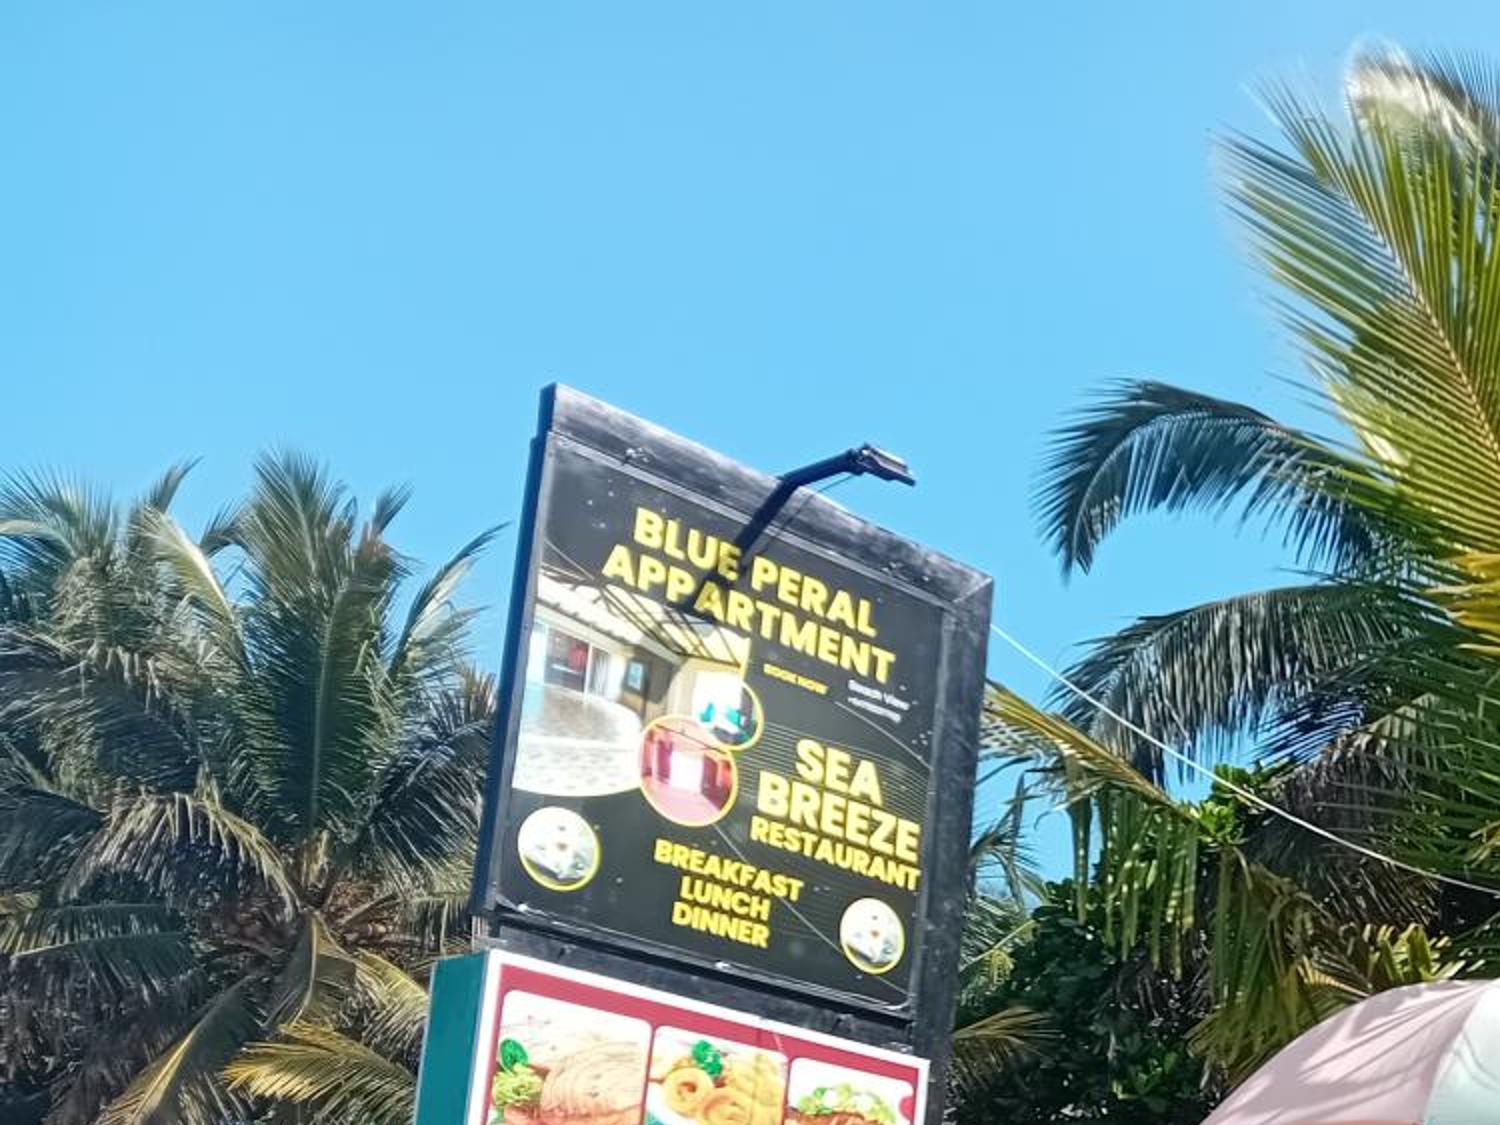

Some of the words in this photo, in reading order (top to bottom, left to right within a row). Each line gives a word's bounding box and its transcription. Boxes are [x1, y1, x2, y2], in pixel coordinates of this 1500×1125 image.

[633, 507, 741, 580] BLUE
[751, 556, 877, 637] PERAL
[602, 544, 896, 685] APPARTMENT
[795, 739, 882, 806] SEA
[757, 770, 921, 862] BREEZE
[654, 839, 804, 901] BREAKFAST
[751, 816, 921, 890] RESTAURANT
[672, 901, 769, 948] DINNER
[680, 876, 770, 921] LUNCH
